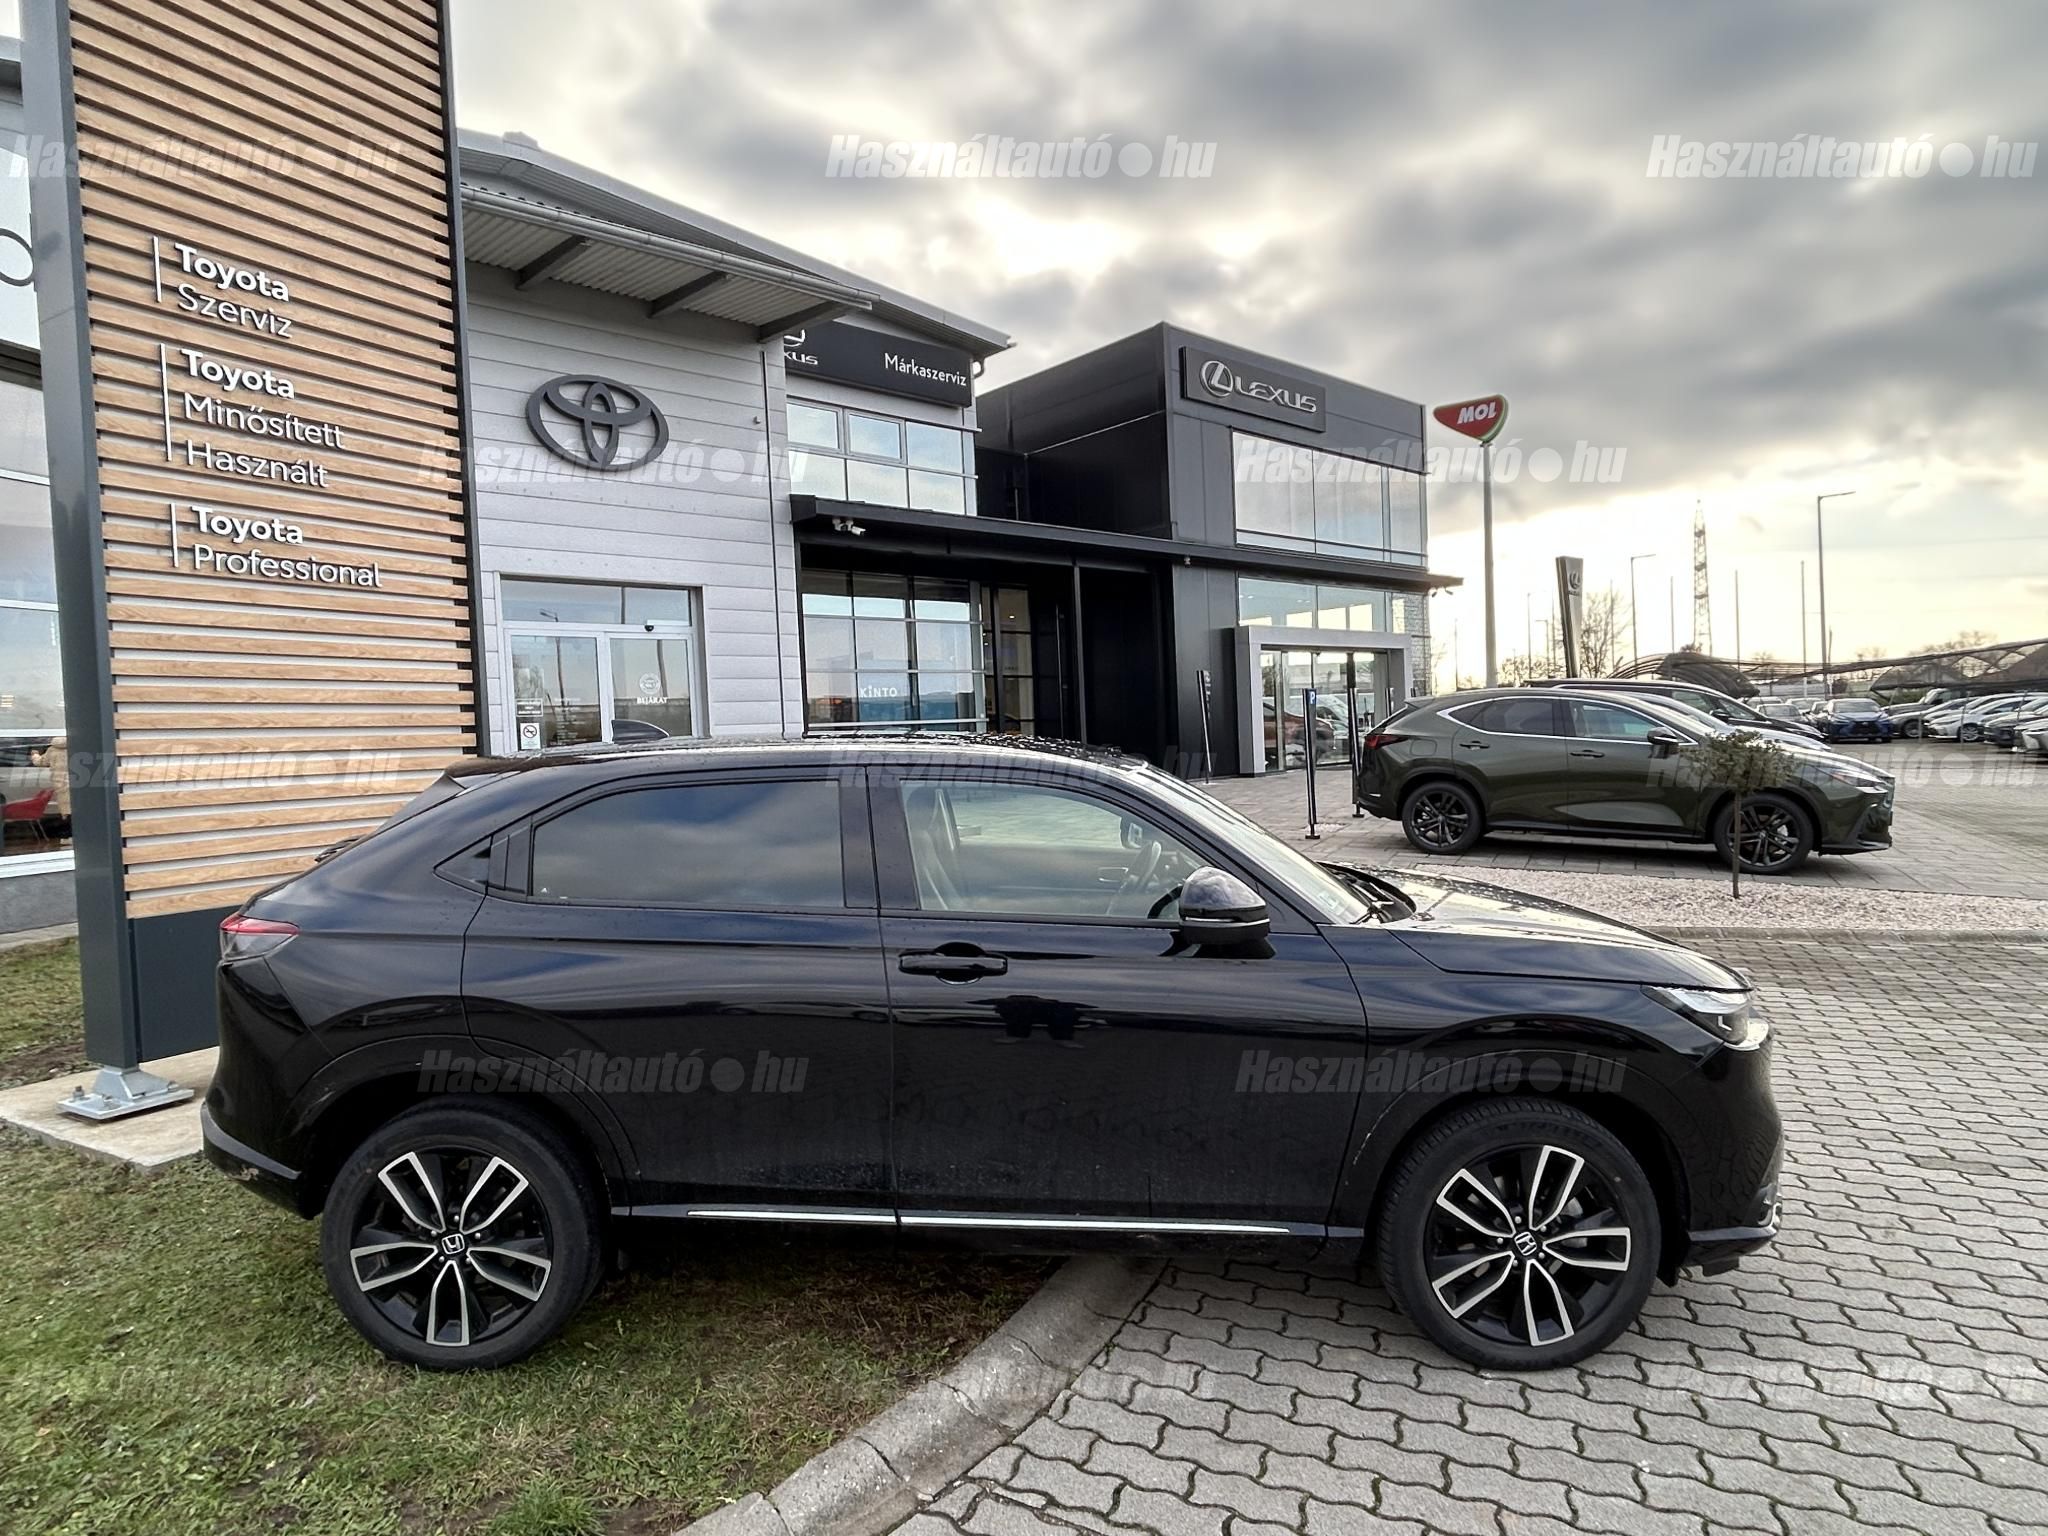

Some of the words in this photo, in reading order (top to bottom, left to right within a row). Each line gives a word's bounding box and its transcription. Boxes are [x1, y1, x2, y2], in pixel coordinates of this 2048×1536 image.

[174, 242, 290, 302] Toyota
[177, 282, 293, 339] Szerviz
[181, 349, 295, 399] Toyota
[884, 353, 967, 386] Márkaszerviz
[1234, 375, 1317, 413] LEXUS
[1456, 401, 1497, 425] MOL
[183, 392, 347, 449] Minősített
[186, 439, 329, 488] Használt
[191, 505, 304, 545] Toyota
[193, 543, 382, 588] Professional
[1310, 691, 1317, 705] P
